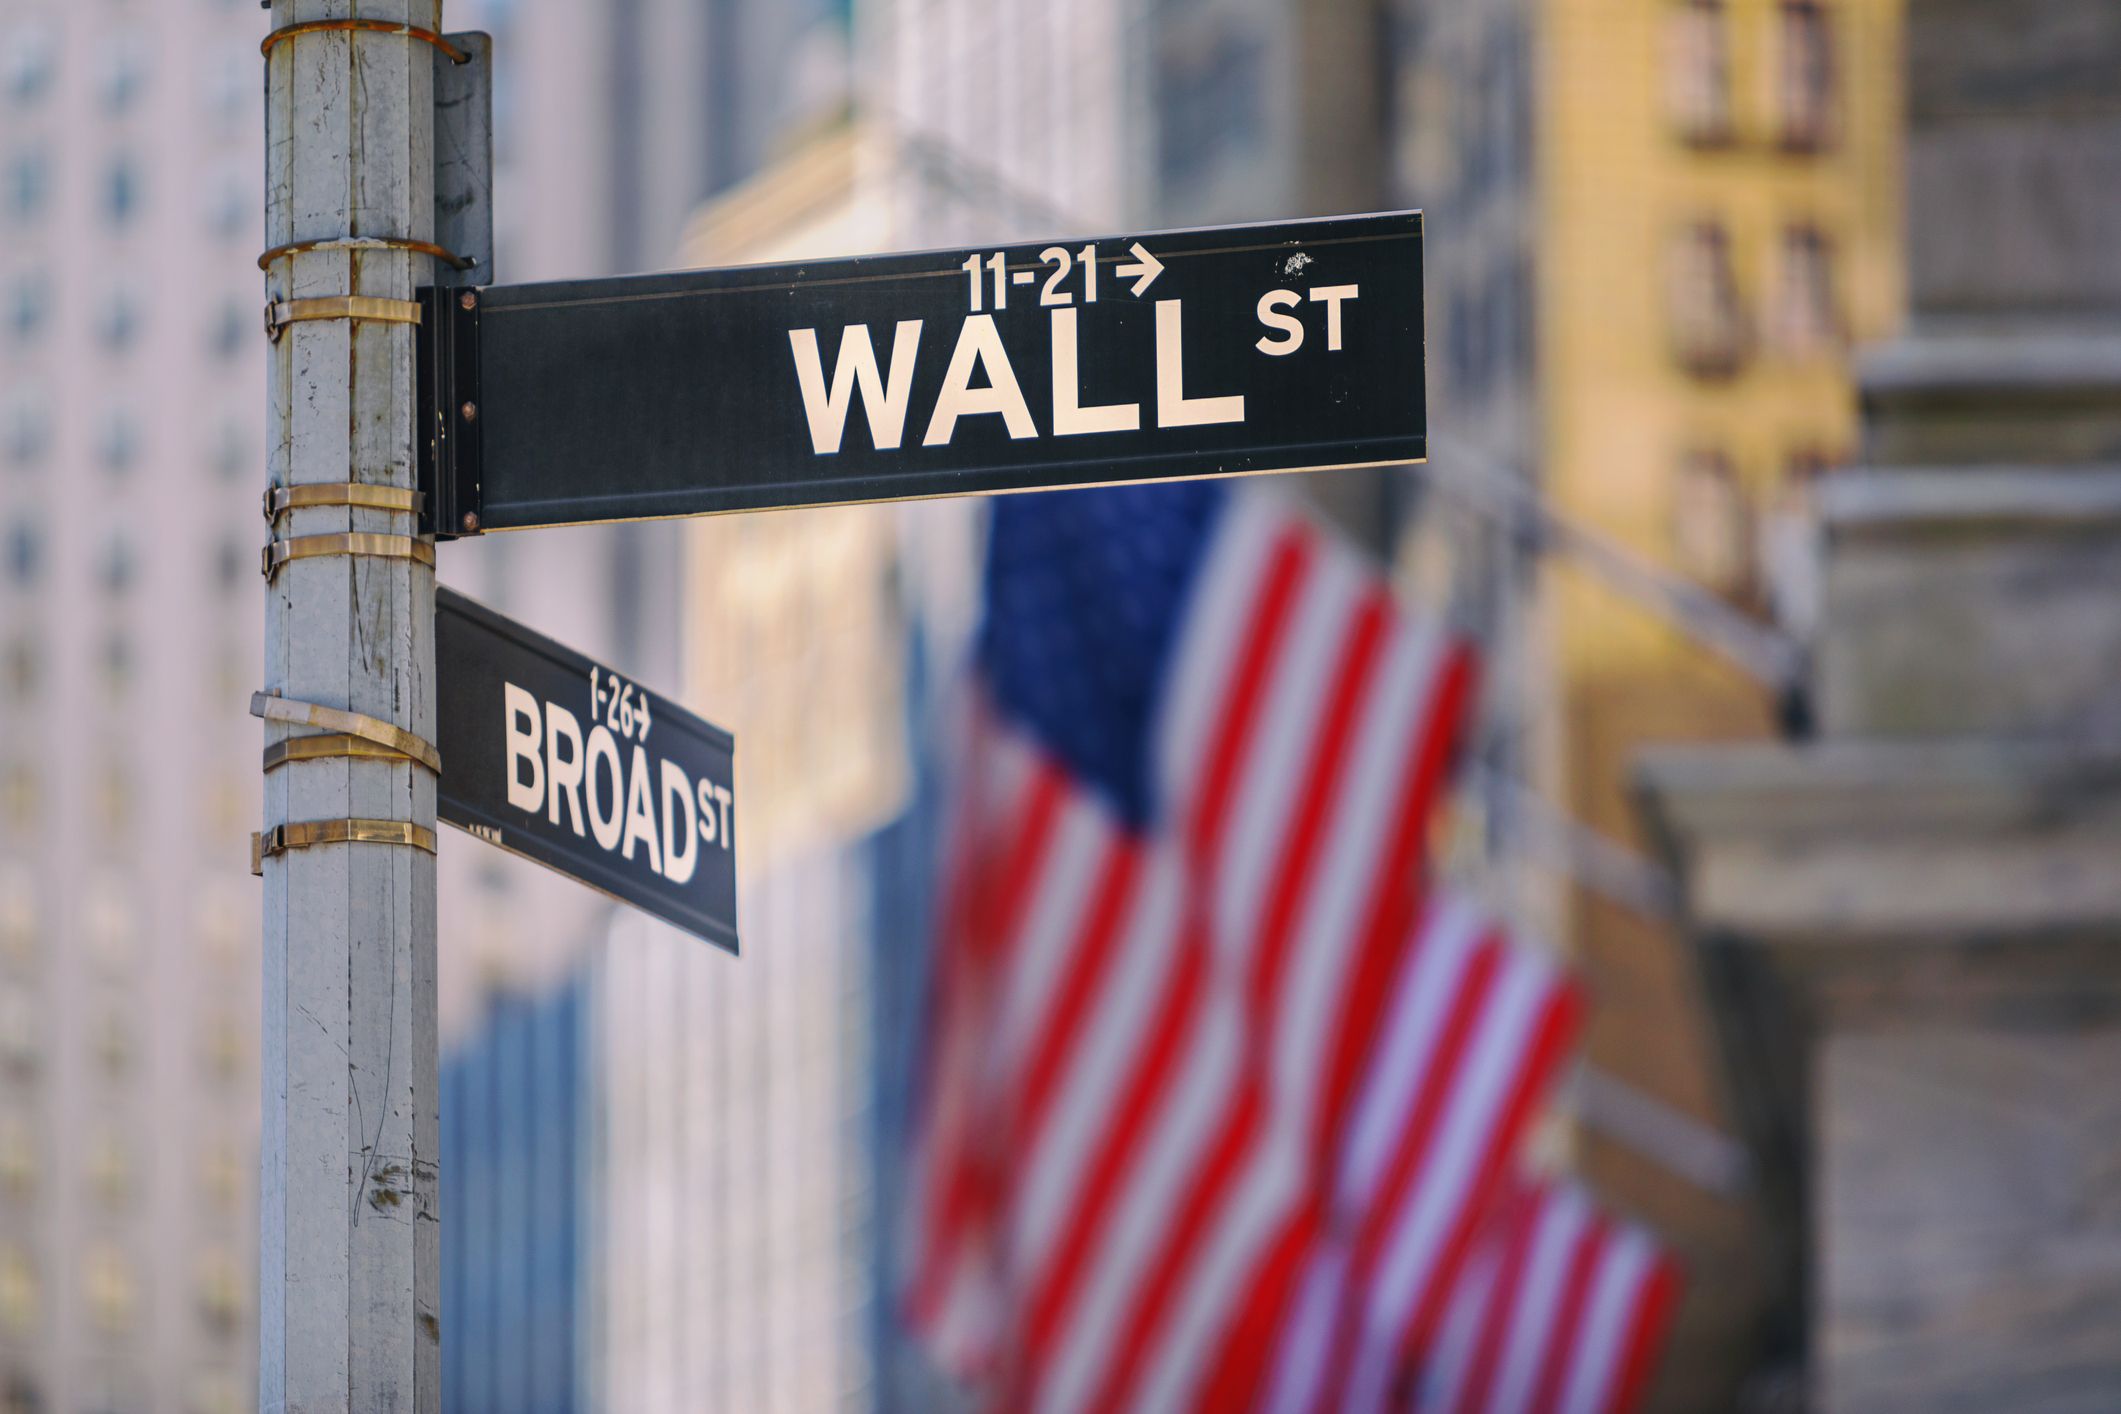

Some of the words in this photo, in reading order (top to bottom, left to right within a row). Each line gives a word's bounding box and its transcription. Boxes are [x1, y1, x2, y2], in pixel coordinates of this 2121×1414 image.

[962, 244, 1098, 312] 11-21
[788, 298, 1246, 456] WALL
[1255, 283, 1360, 357] ST
[590, 666, 634, 739] 1-26
[504, 681, 698, 885] BROAD
[698, 777, 732, 850] ST
